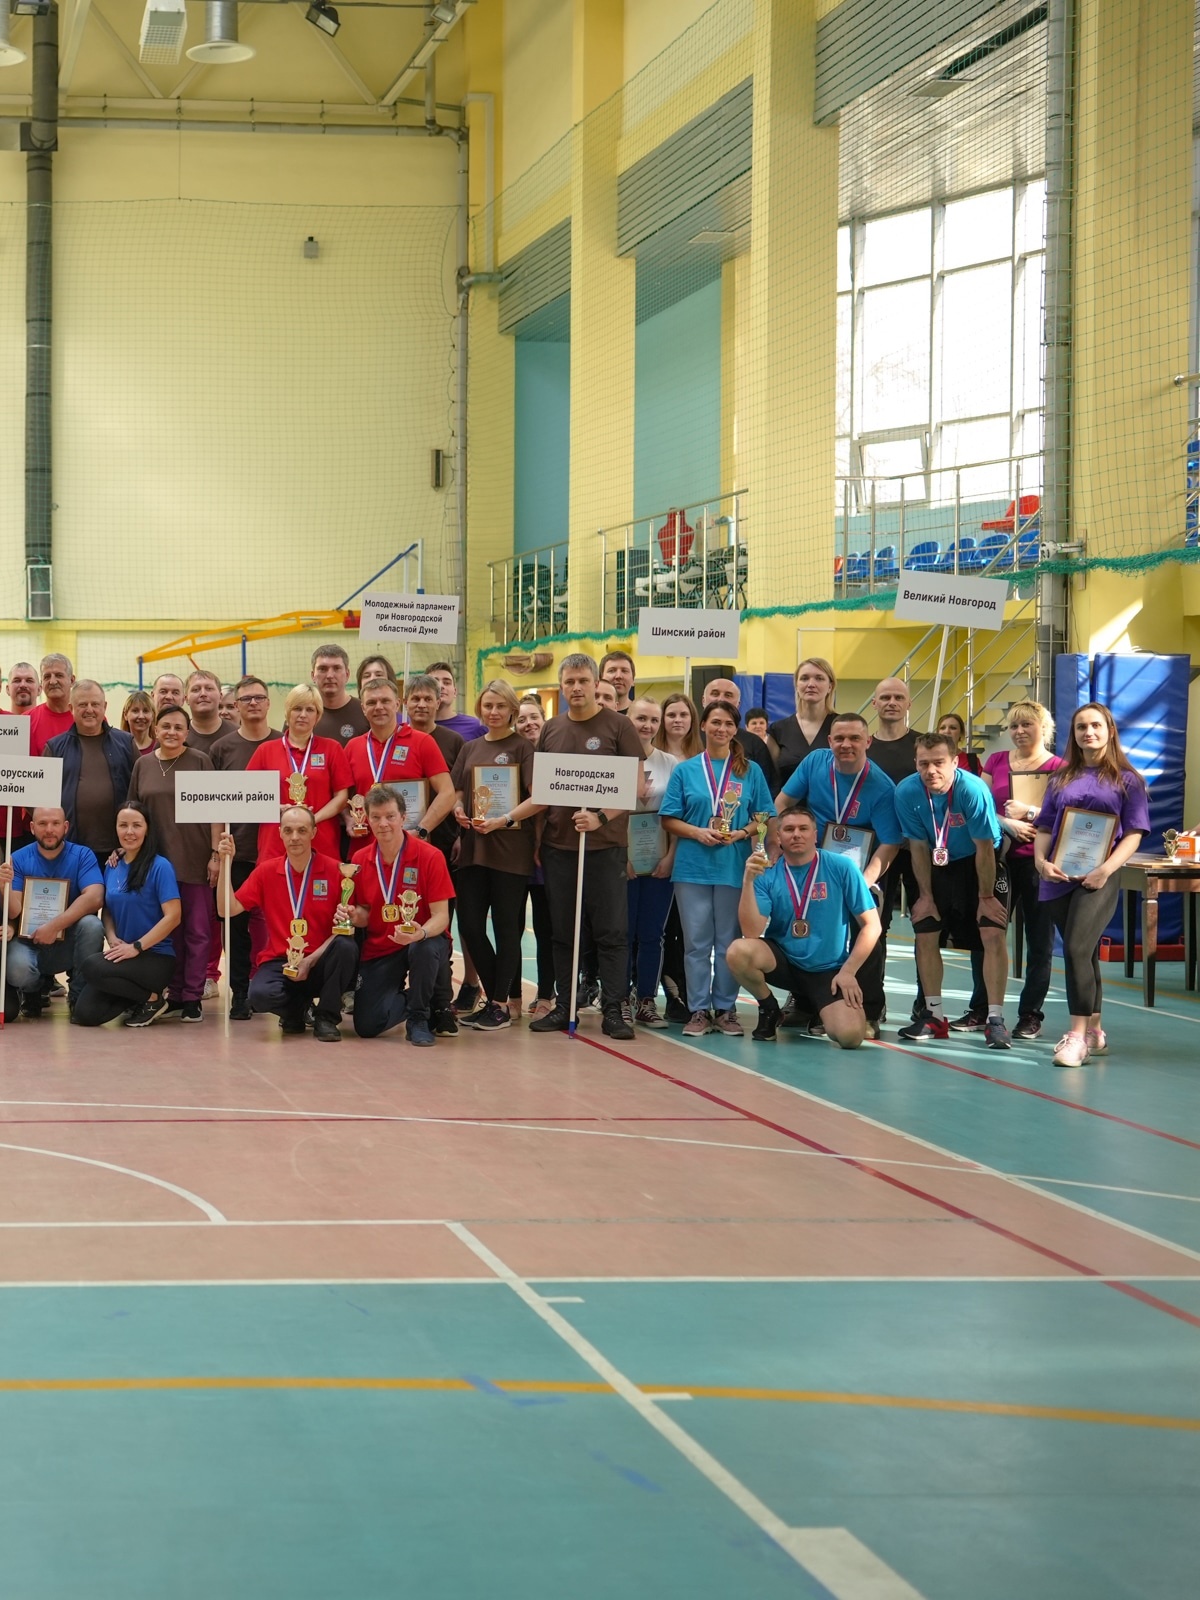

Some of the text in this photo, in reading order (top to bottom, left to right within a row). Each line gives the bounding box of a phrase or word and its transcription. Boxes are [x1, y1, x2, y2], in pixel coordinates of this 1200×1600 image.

[364, 599, 456, 611] Молодежный парламент
[903, 590, 997, 611] Великий Новгород
[391, 612, 443, 623] Новгородской
[378, 624, 439, 635] областной Думе
[651, 626, 726, 640] Шимский район
[555, 767, 615, 780] Новгородская
[549, 781, 619, 795] областная Дума
[180, 791, 275, 804] Боровичский район
